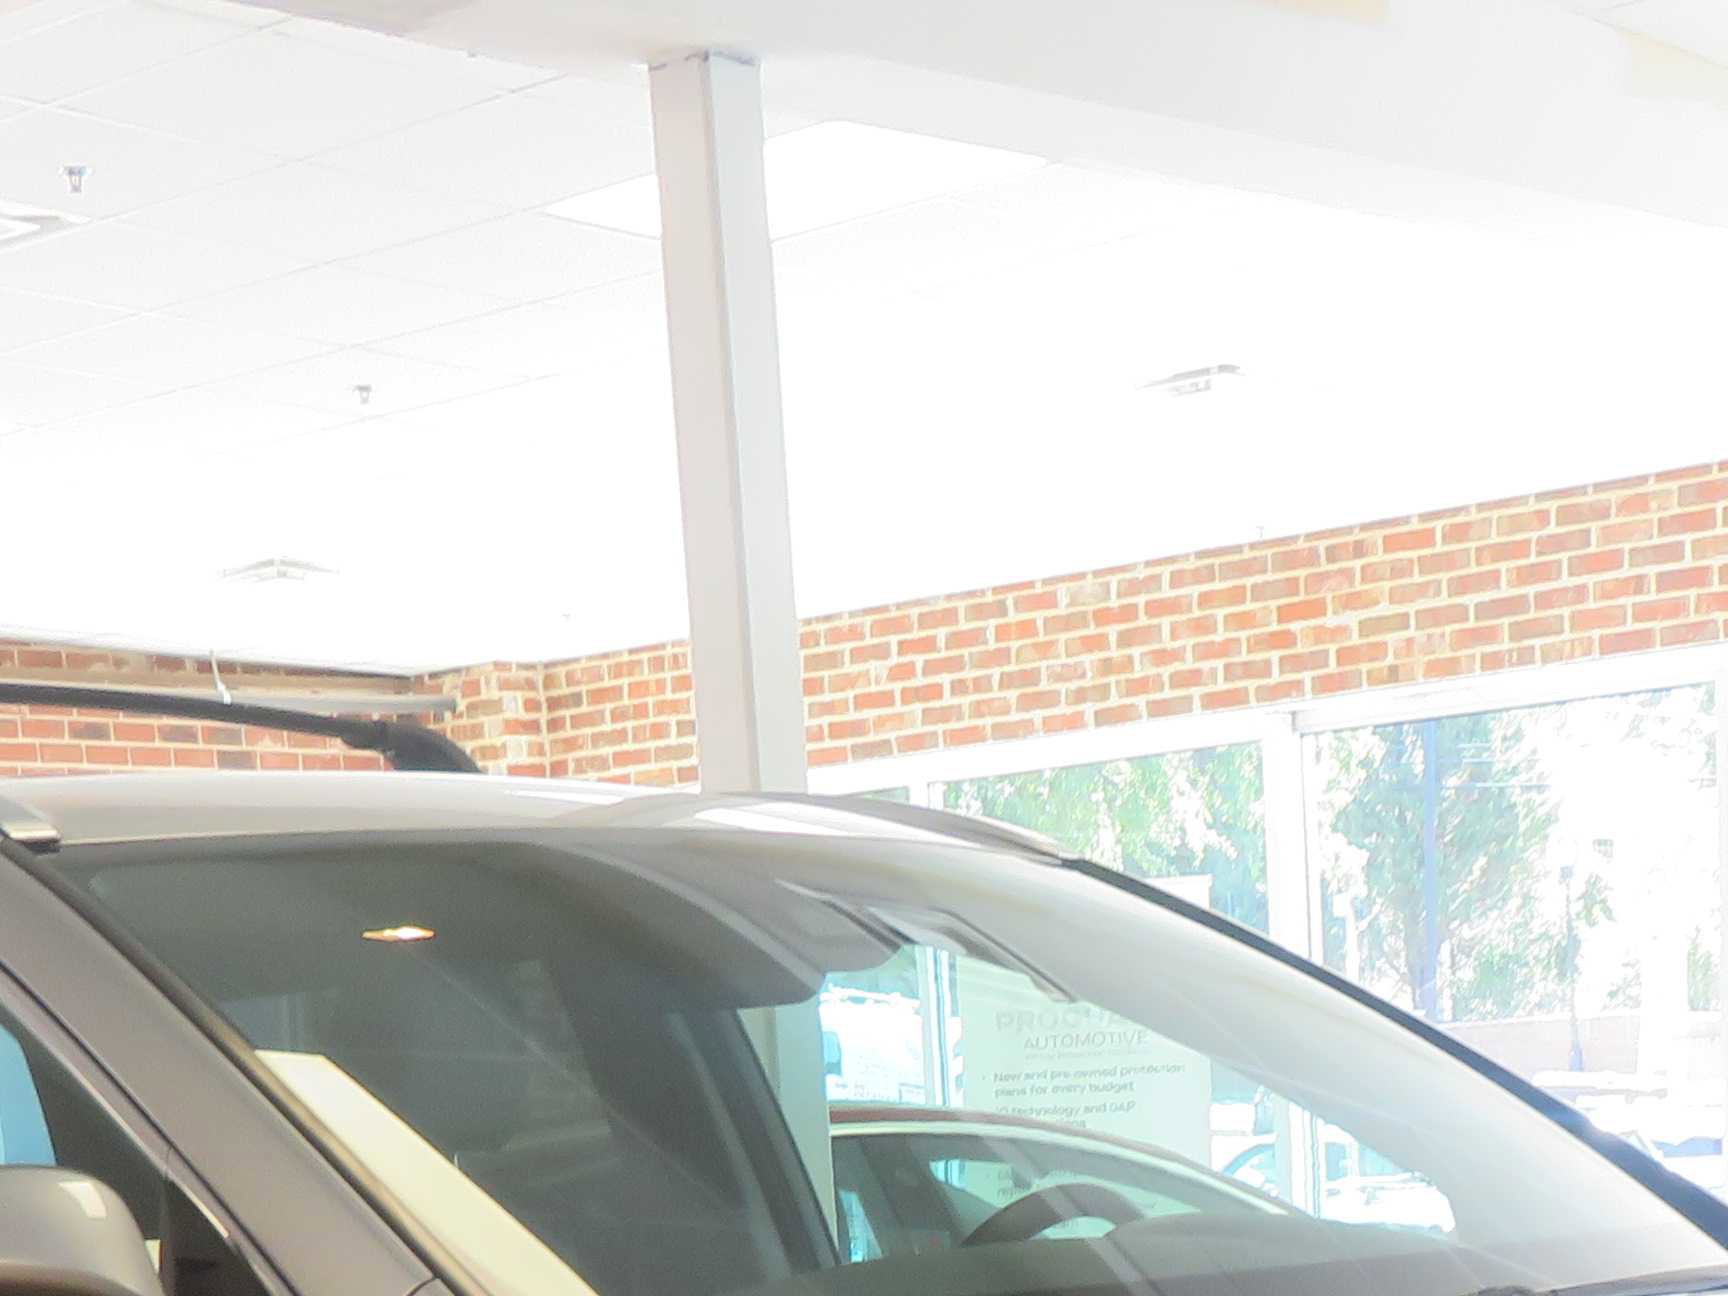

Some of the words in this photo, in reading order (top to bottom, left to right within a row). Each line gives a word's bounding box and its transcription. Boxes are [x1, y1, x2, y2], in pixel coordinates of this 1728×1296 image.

[1022, 1030, 1148, 1051] AUTOMOTIVE
[1029, 1084, 1049, 1096] for
[1087, 1080, 1136, 1095] budget
